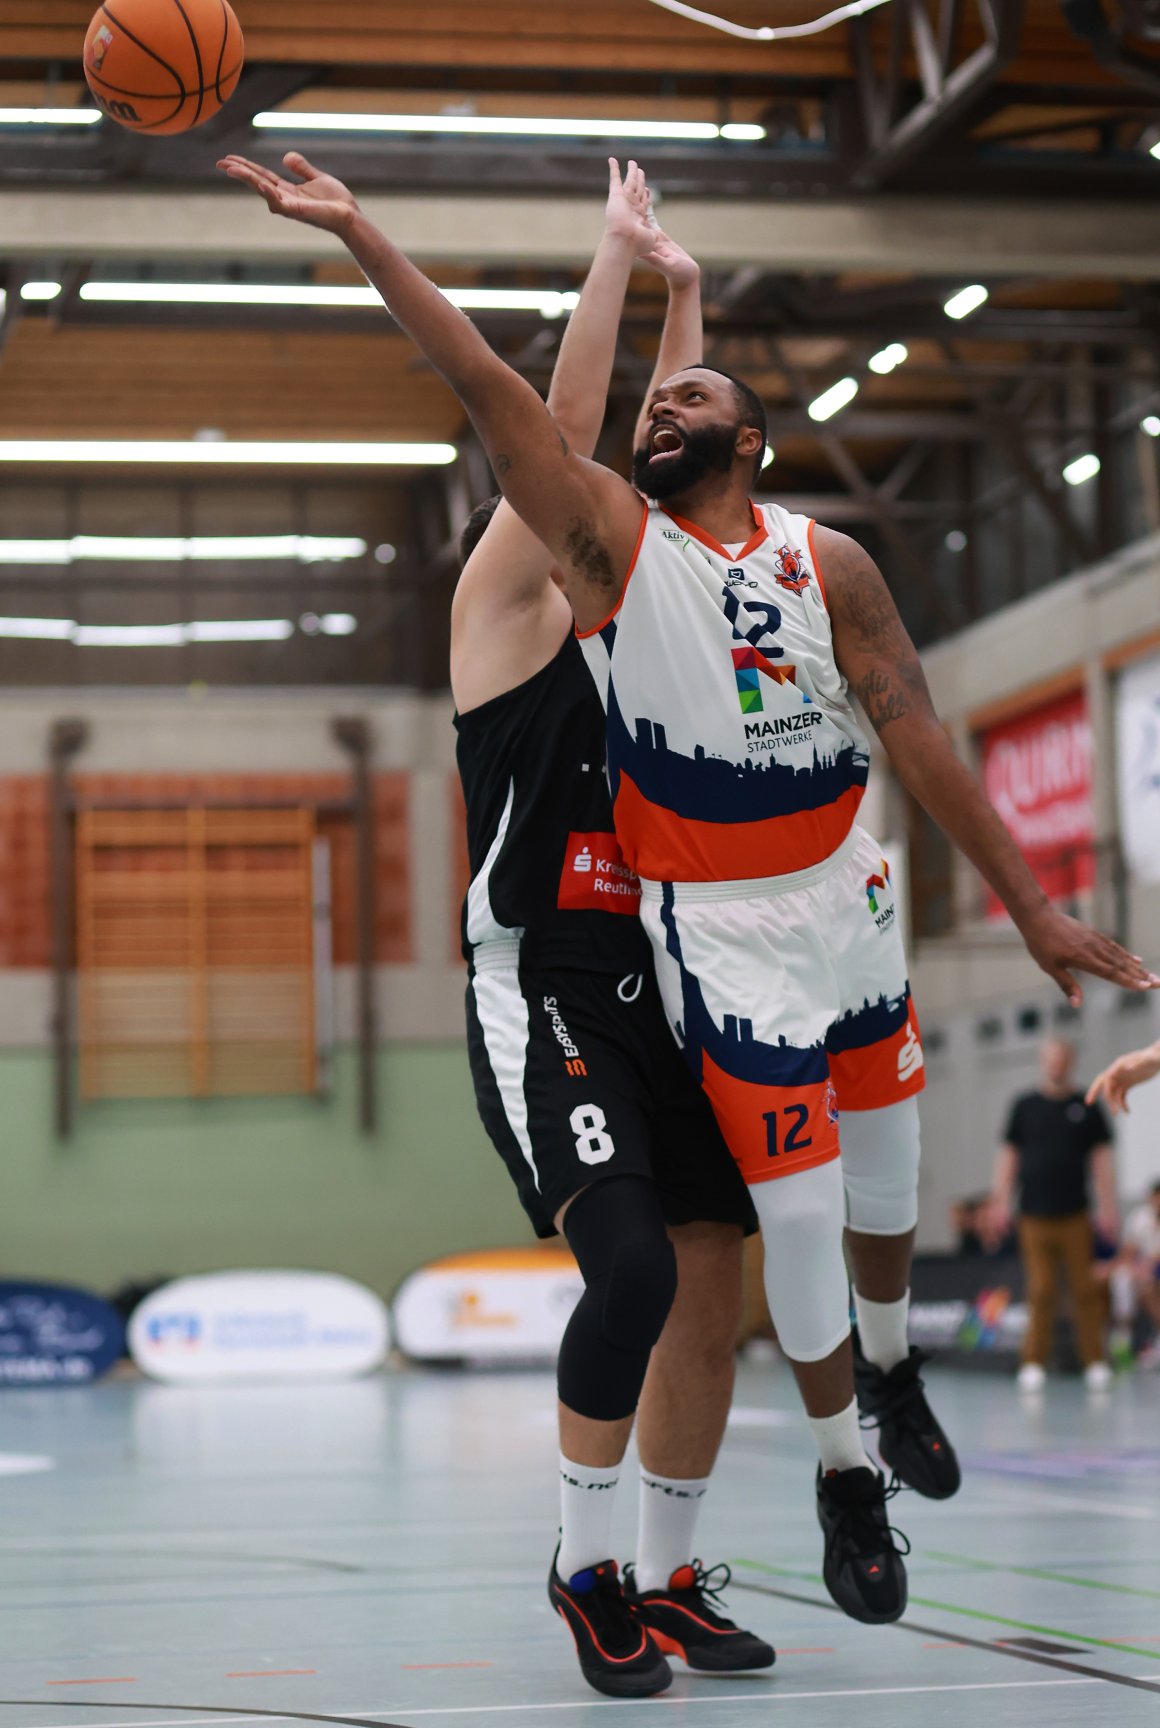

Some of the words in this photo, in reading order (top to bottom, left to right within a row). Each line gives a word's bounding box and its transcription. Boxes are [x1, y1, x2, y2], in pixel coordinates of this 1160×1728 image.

[721, 585, 785, 659] 12
[744, 711, 823, 739] MAINZER
[747, 730, 813, 753] STADTWERKE
[874, 902, 895, 928] MAIN
[569, 1103, 616, 1166] 8
[762, 1103, 813, 1158] 12
